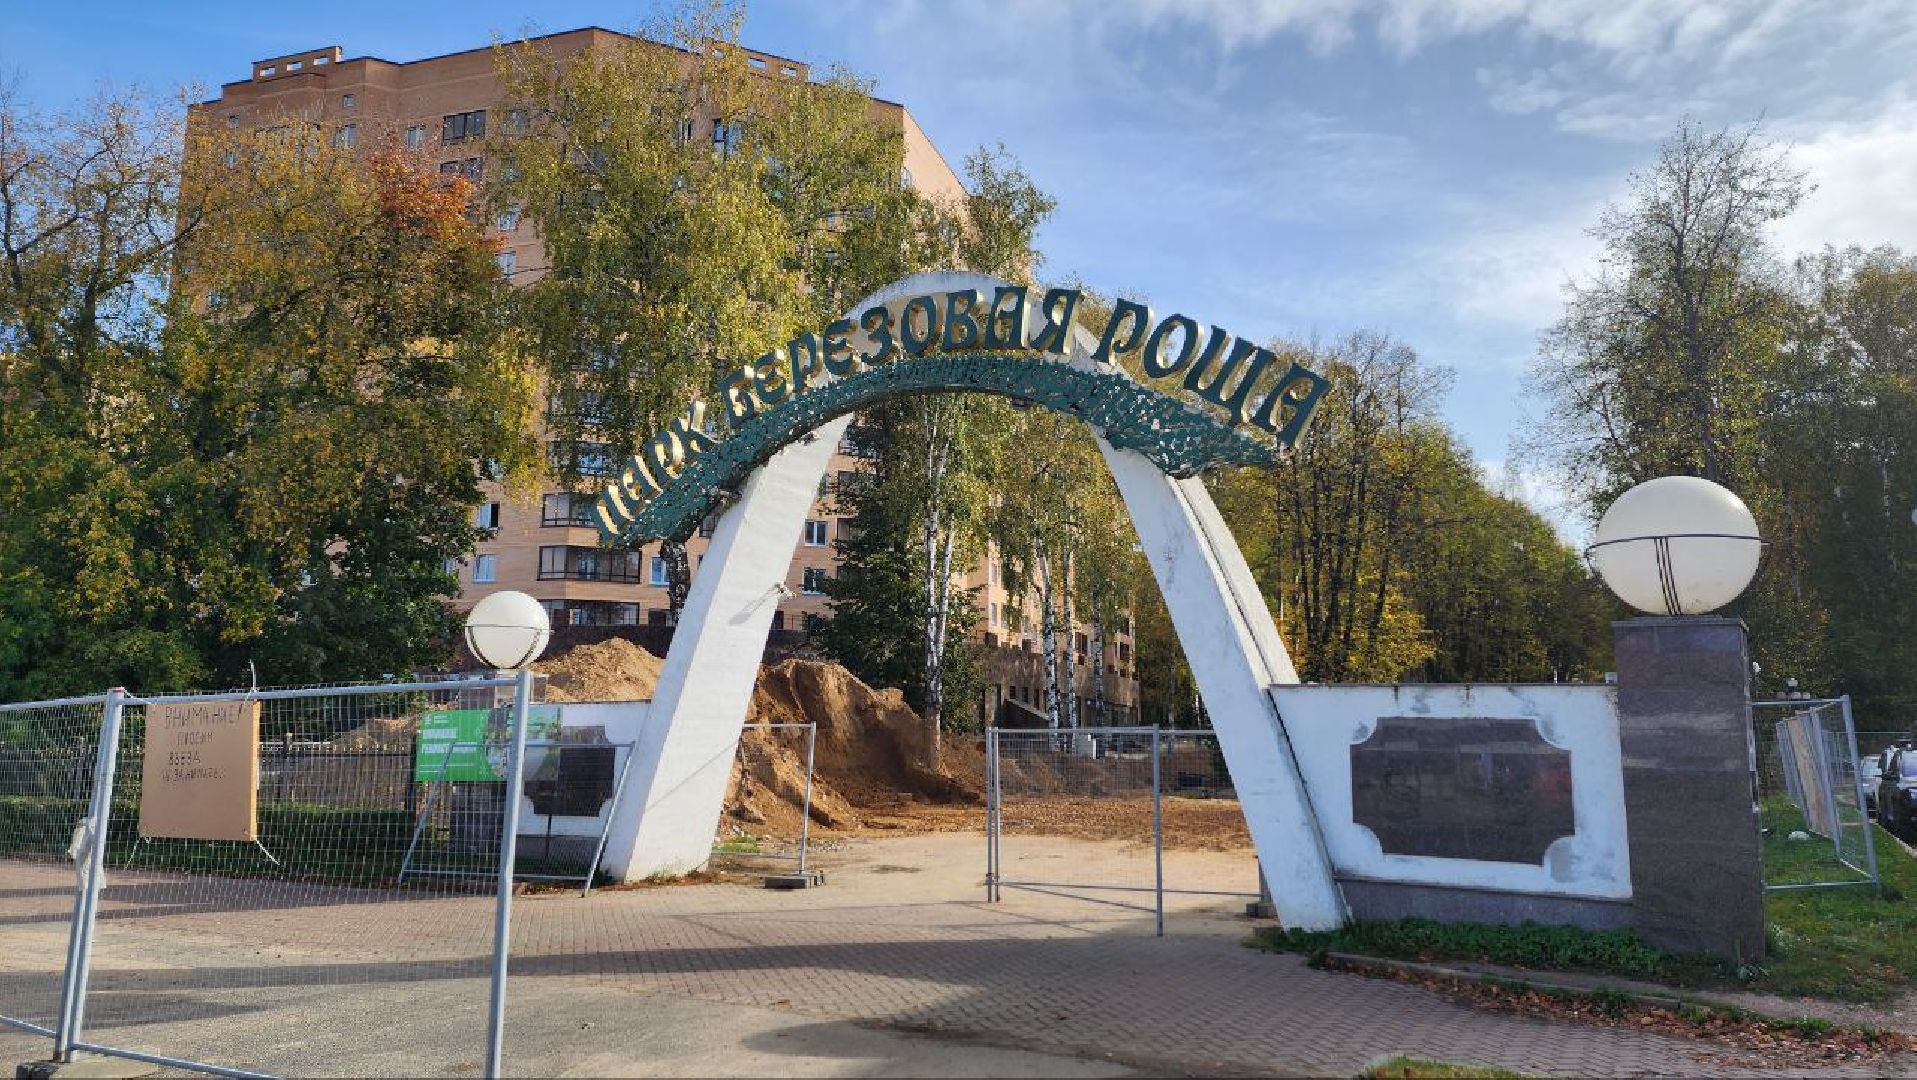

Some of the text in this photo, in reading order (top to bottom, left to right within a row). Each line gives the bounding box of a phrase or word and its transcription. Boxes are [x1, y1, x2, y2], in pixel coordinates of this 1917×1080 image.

[595, 286, 1330, 546] ПАРК БЕРЕЗОВАЯ РОЩА
